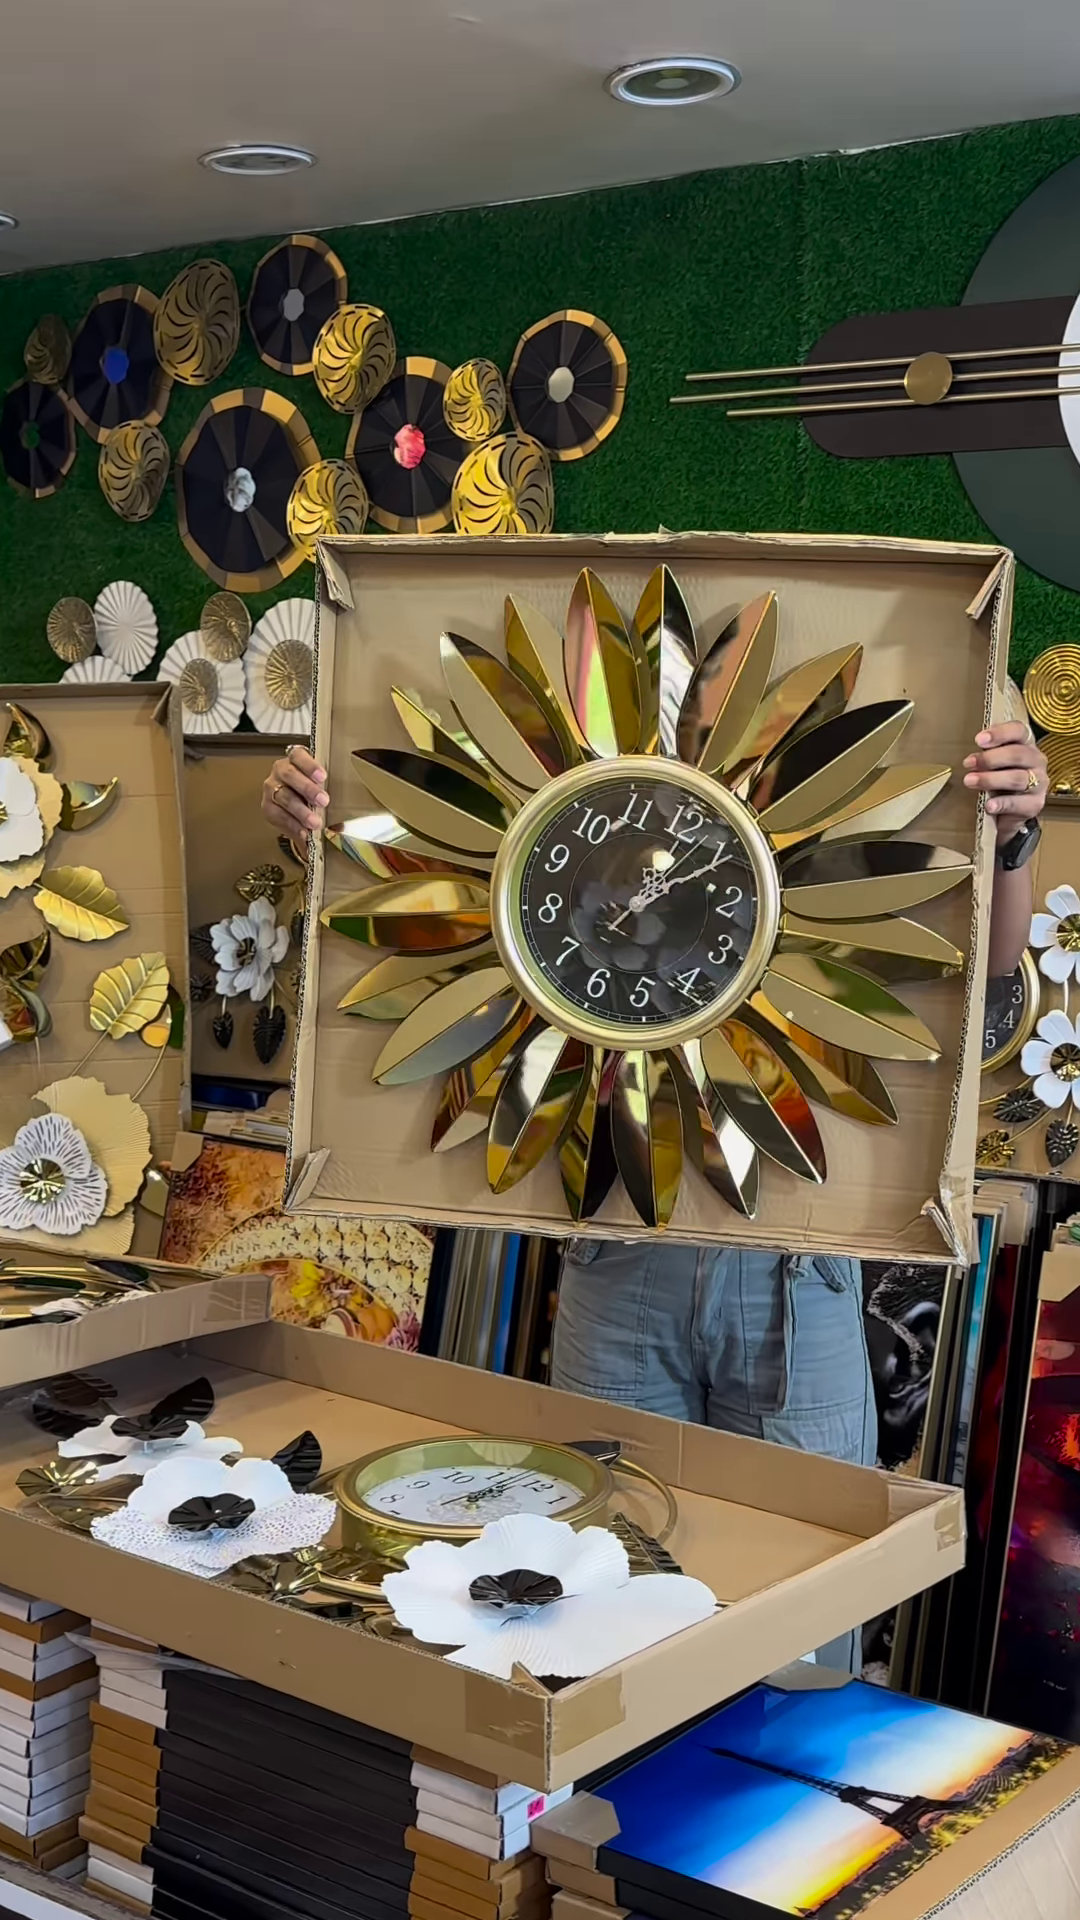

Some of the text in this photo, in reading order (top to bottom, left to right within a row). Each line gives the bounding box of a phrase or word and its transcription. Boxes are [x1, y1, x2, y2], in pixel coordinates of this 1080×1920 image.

[572, 807, 611, 845] 10
[617, 793, 653, 830] 11
[664, 804, 704, 844] 12
[544, 844, 570, 873] 9
[705, 841, 726, 872] 1
[538, 893, 563, 923] 8
[715, 886, 743, 918] 2
[555, 936, 580, 966] 7
[708, 934, 733, 964] 3
[586, 968, 611, 998] 6
[629, 976, 656, 1007] 5
[677, 967, 701, 995] 4
[1012, 984, 1023, 1004] 3
[1003, 1009, 1015, 1028] 4
[985, 1029, 996, 1048] 5
[406, 1480, 431, 1490] 9
[441, 1471, 475, 1485] 10
[520, 1480, 554, 1493] 12
[379, 1493, 405, 1504] 8
[546, 1496, 567, 1505] 1
